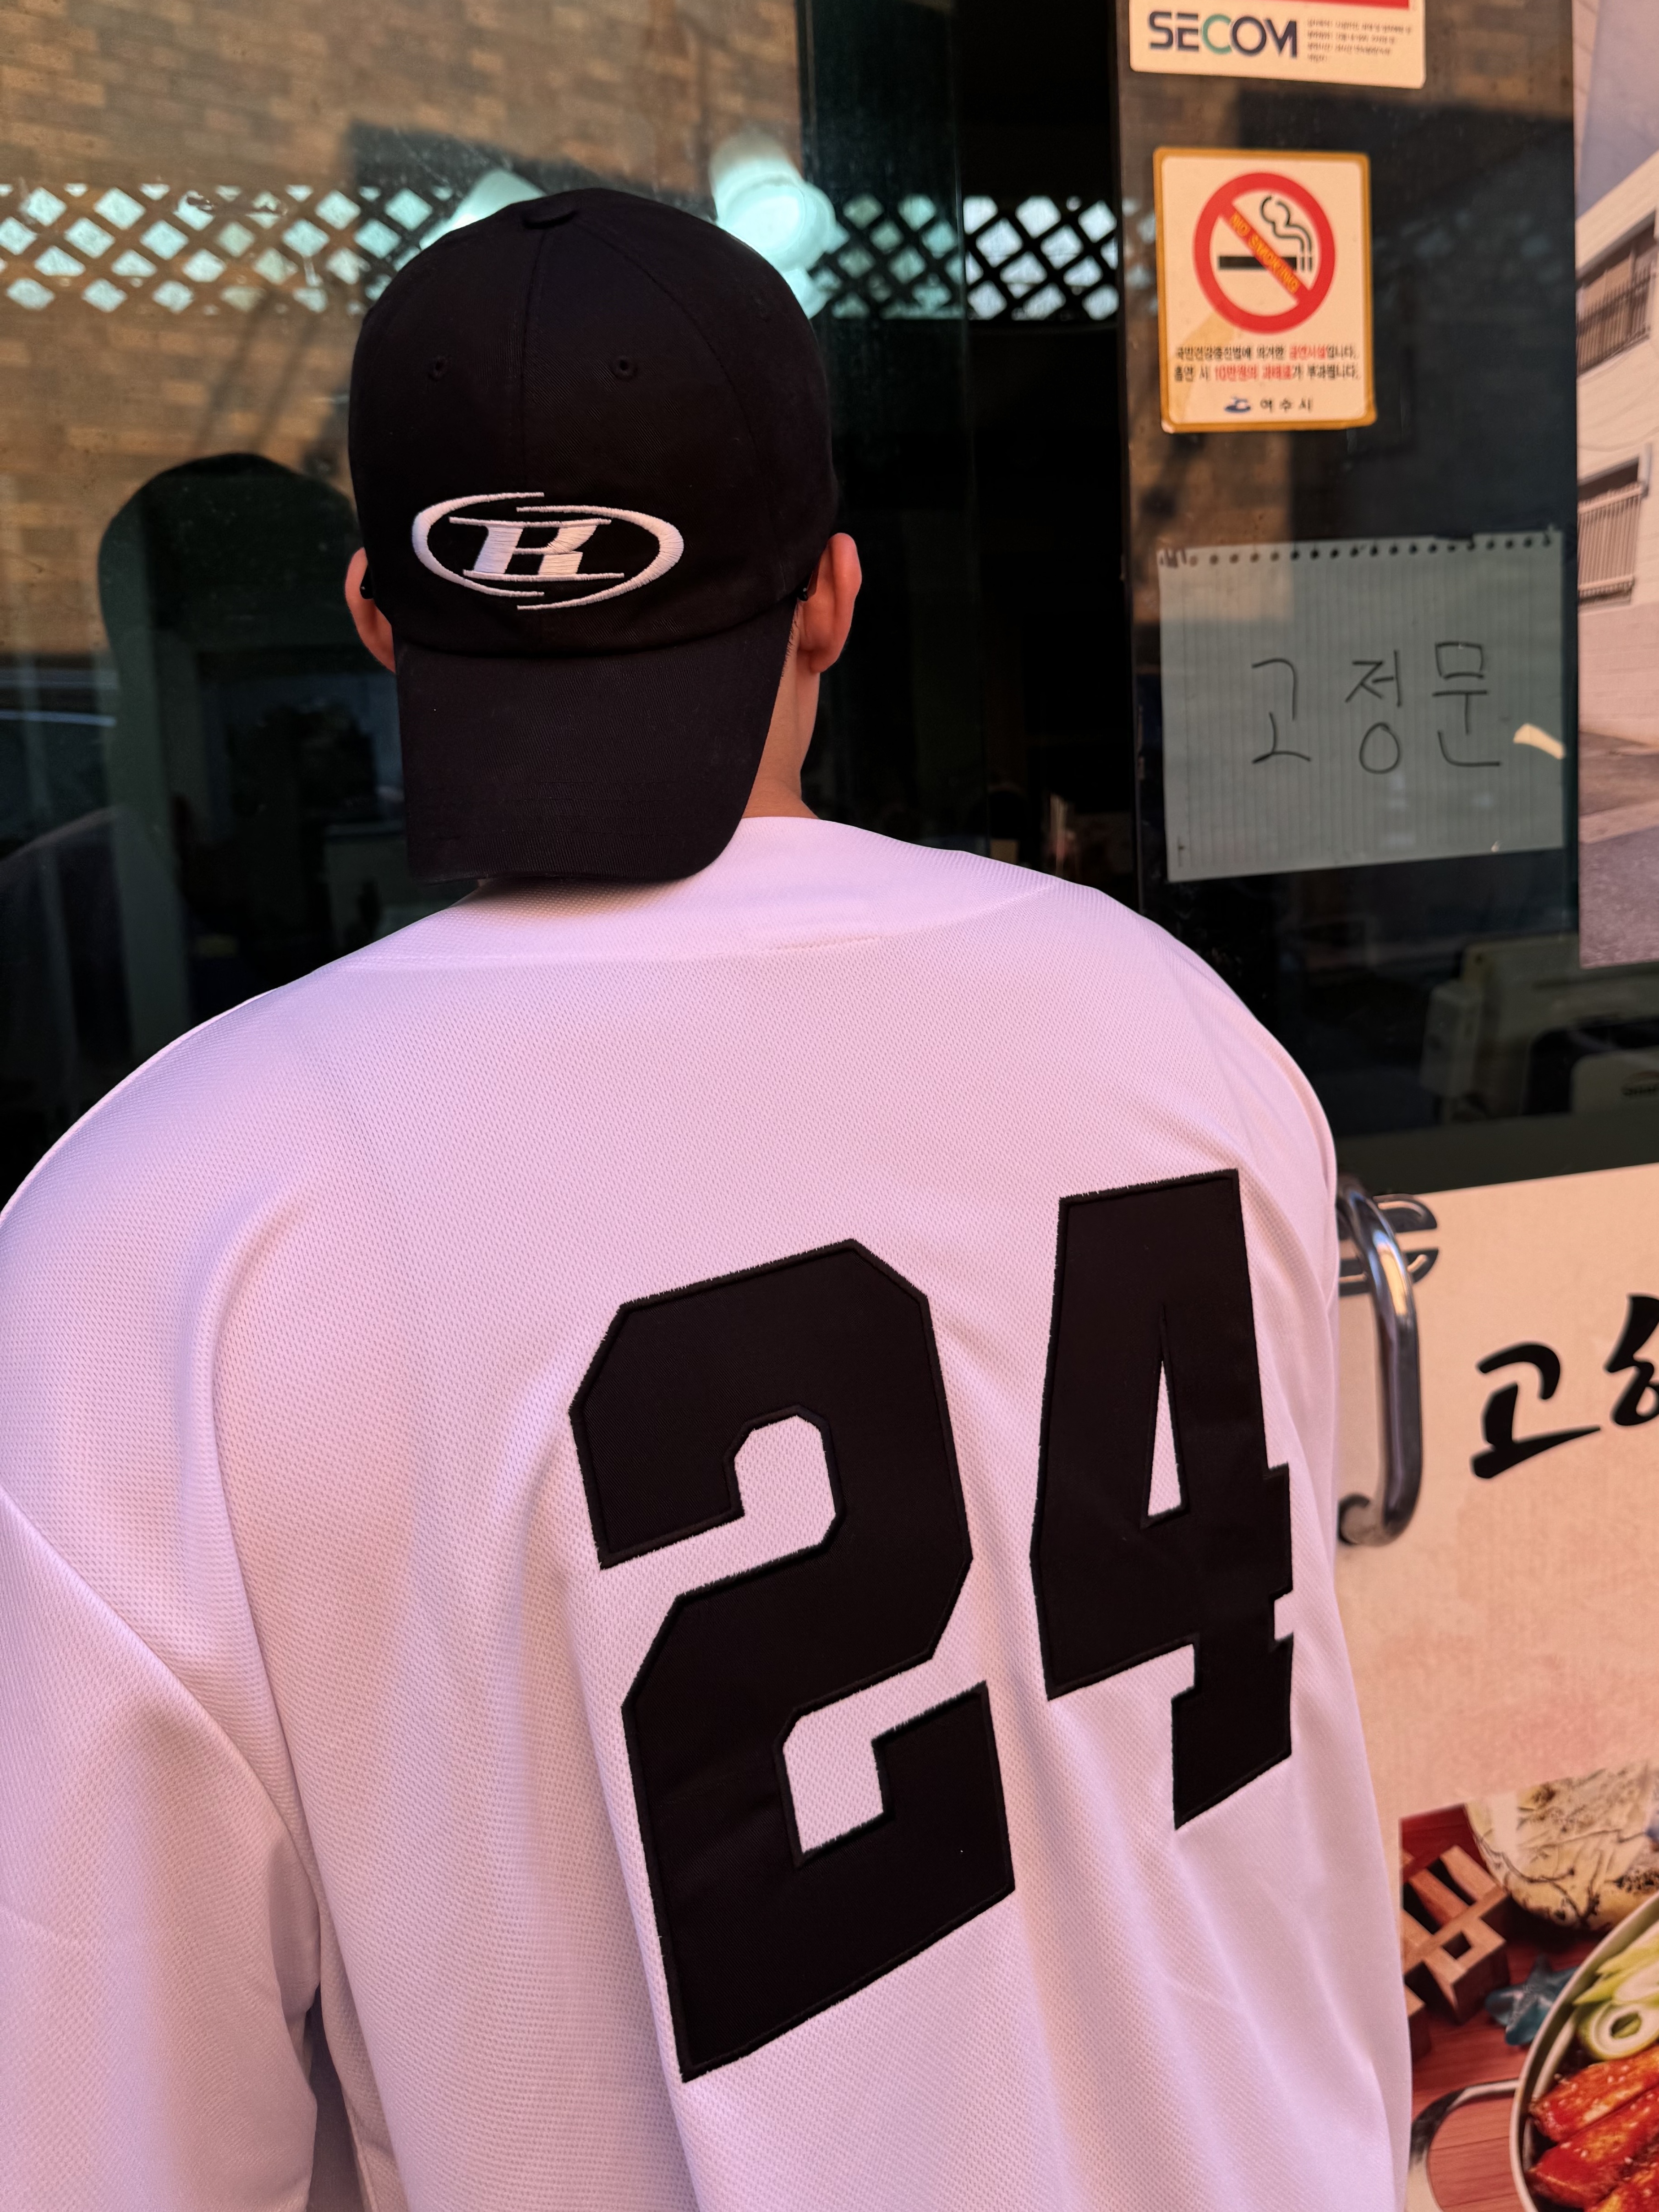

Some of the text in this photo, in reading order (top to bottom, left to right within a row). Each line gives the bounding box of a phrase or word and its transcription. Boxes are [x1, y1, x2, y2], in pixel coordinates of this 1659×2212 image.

[1149, 11, 1298, 58] SECOM
[1230, 212, 1299, 294] NO SMOKING
[1252, 642, 1502, 774] 고정문
[569, 1169, 1294, 2083] 24
